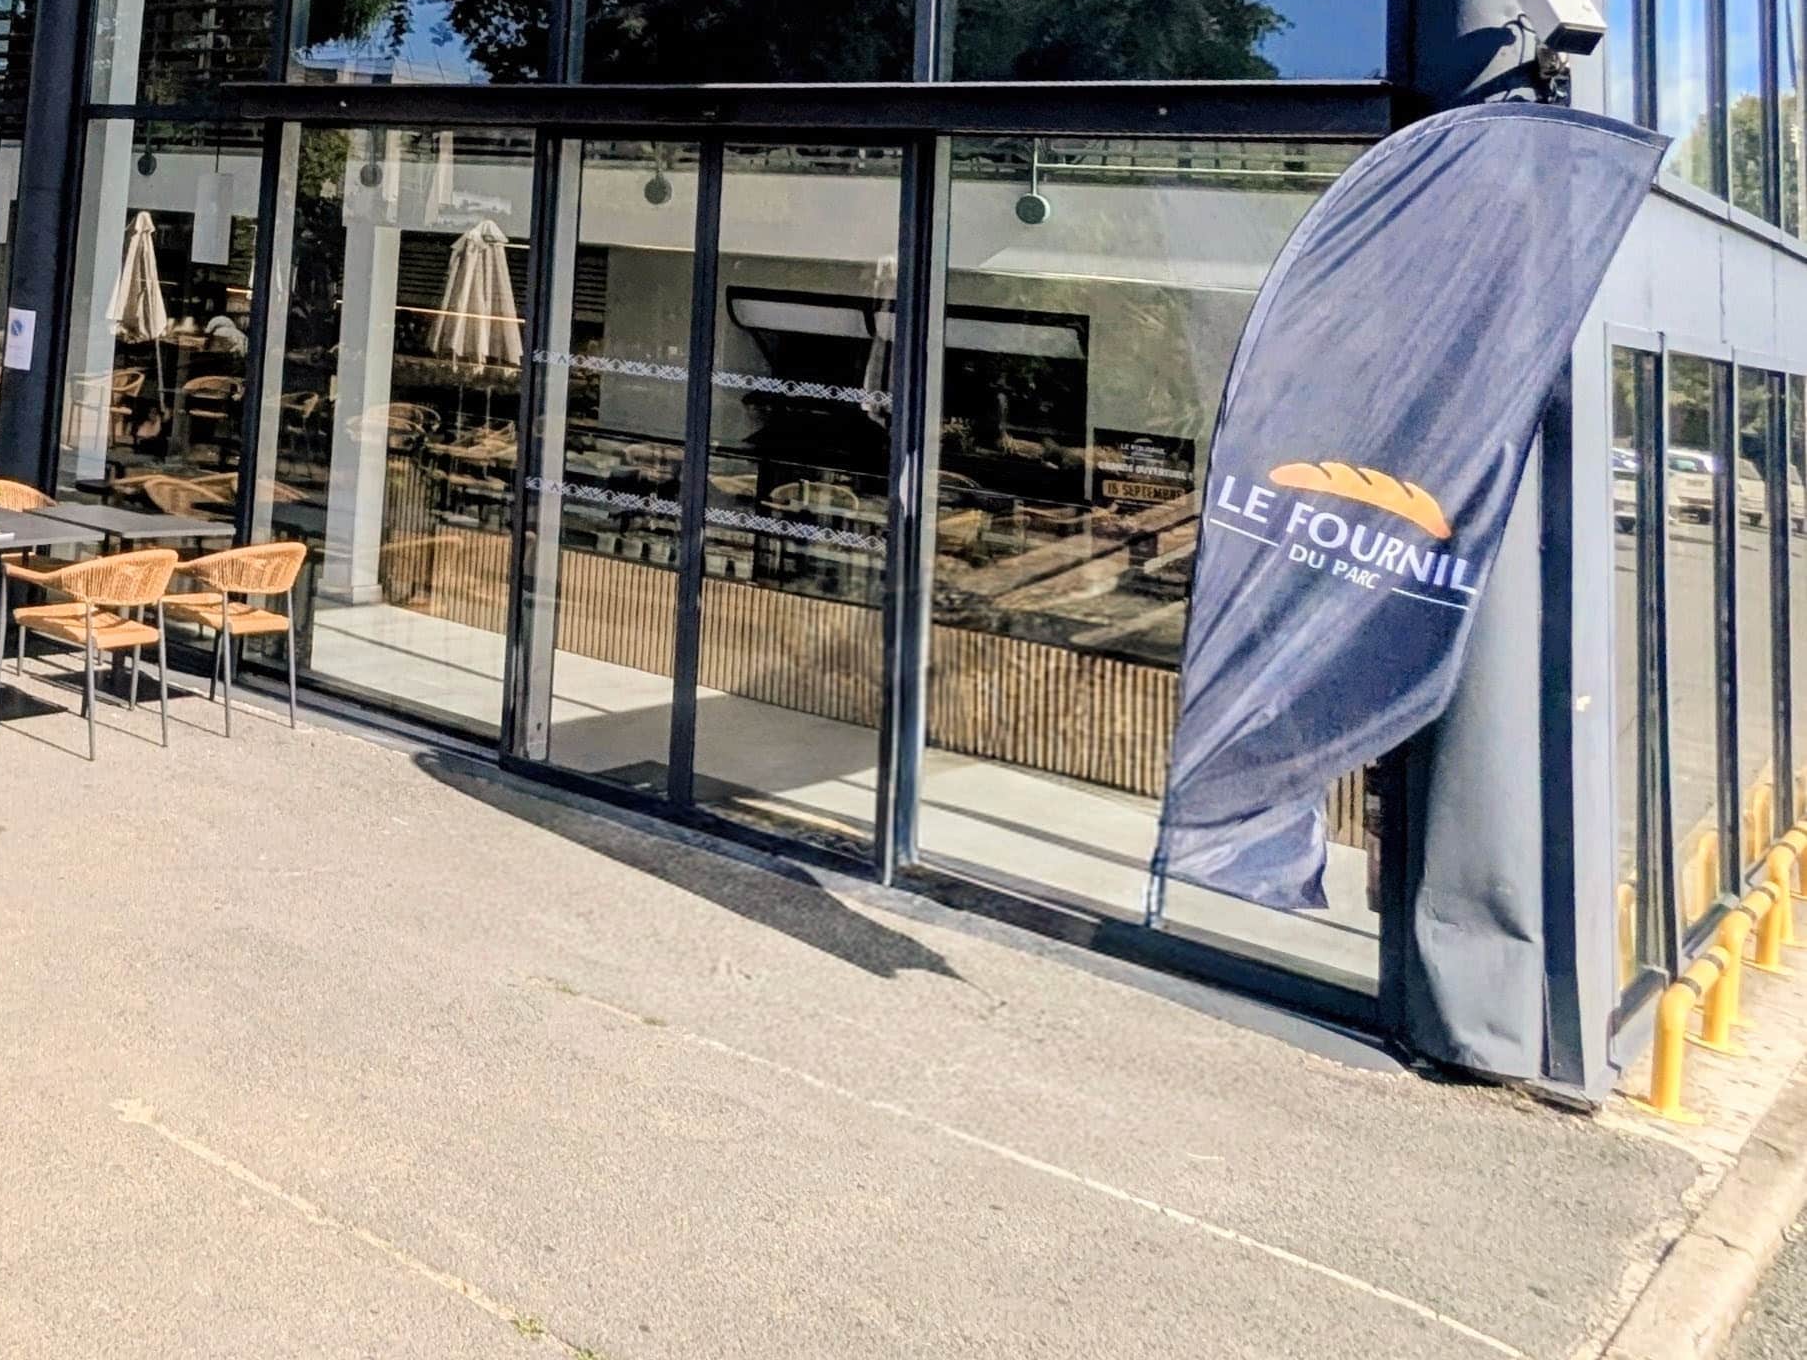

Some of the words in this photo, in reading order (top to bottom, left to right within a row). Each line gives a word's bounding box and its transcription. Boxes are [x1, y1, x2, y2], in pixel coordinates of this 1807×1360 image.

[1217, 475, 1277, 524] LE
[1285, 501, 1478, 595] FOURNIL
[1288, 543, 1326, 569] DU
[1332, 559, 1382, 589] PARC
